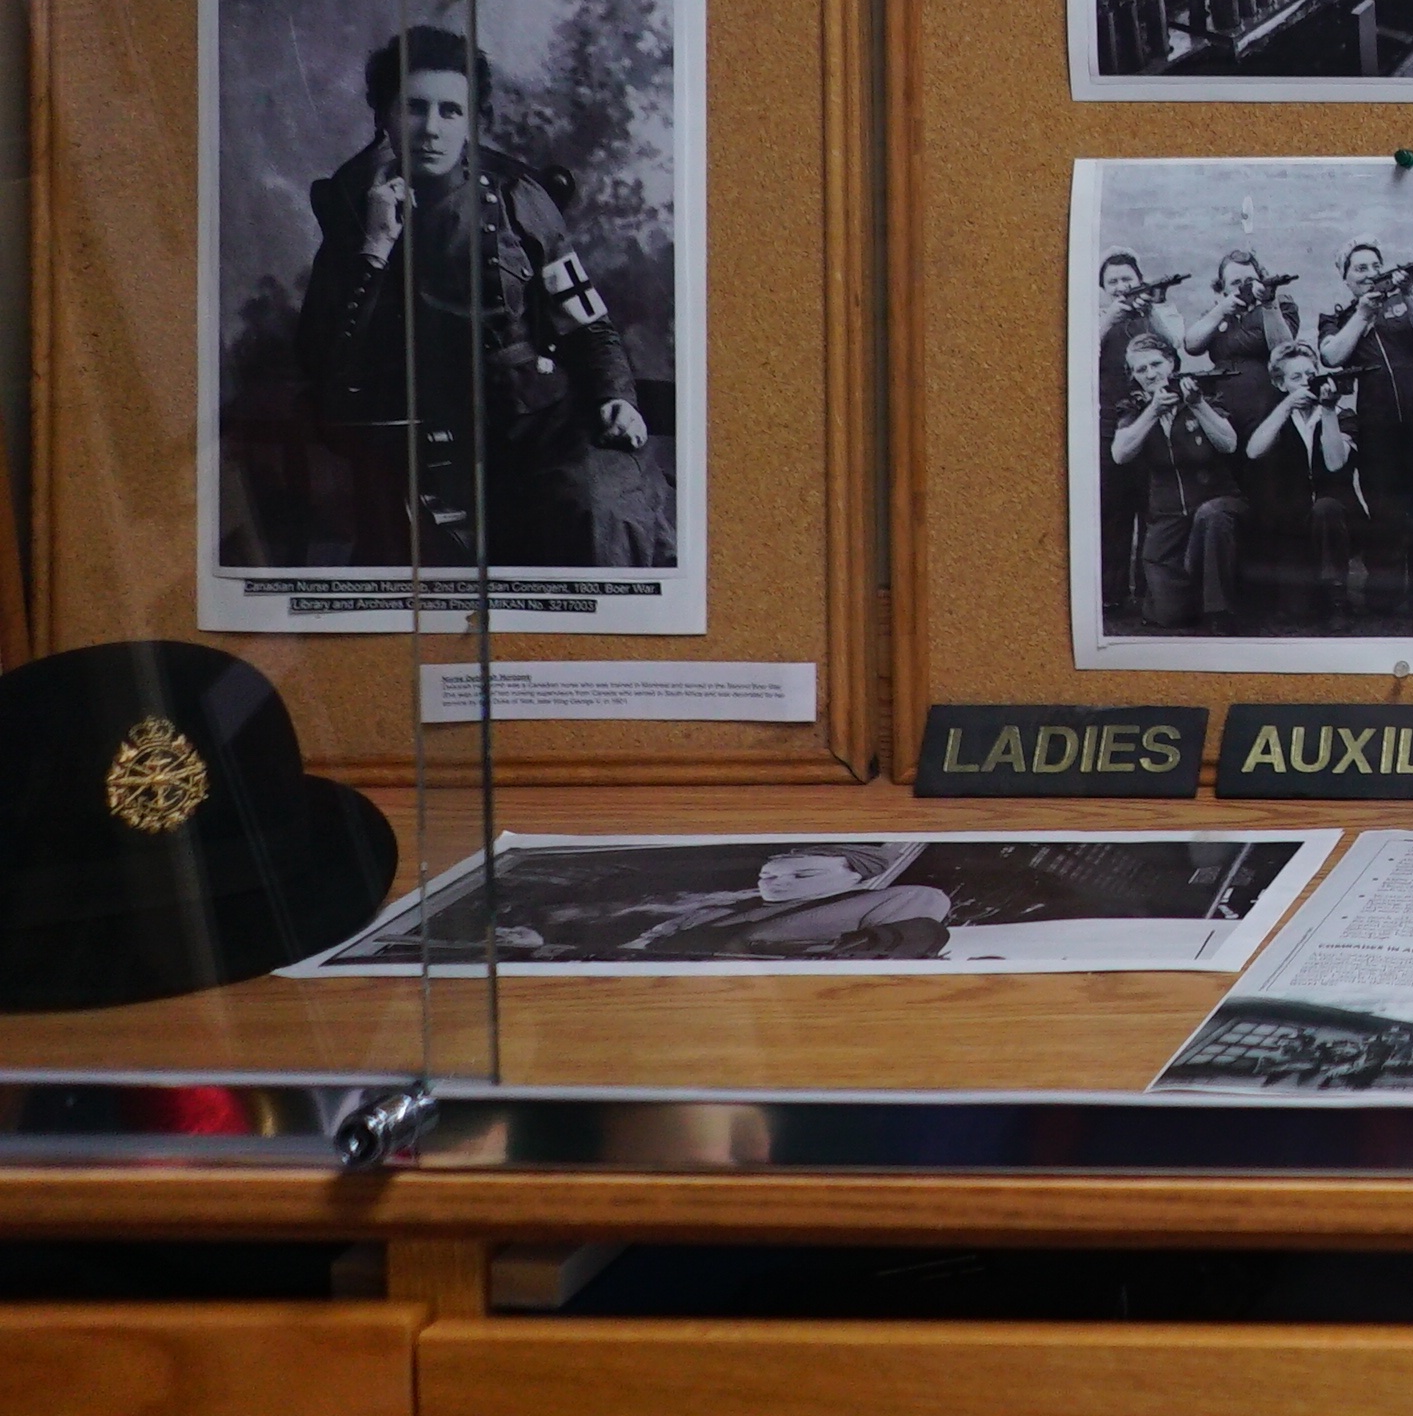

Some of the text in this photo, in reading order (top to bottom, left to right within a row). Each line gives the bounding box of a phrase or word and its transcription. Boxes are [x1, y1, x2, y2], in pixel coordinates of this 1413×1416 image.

[381, 581, 430, 593] Hurcob,
[457, 583, 511, 593] Candian
[943, 724, 1182, 774] LADIES
